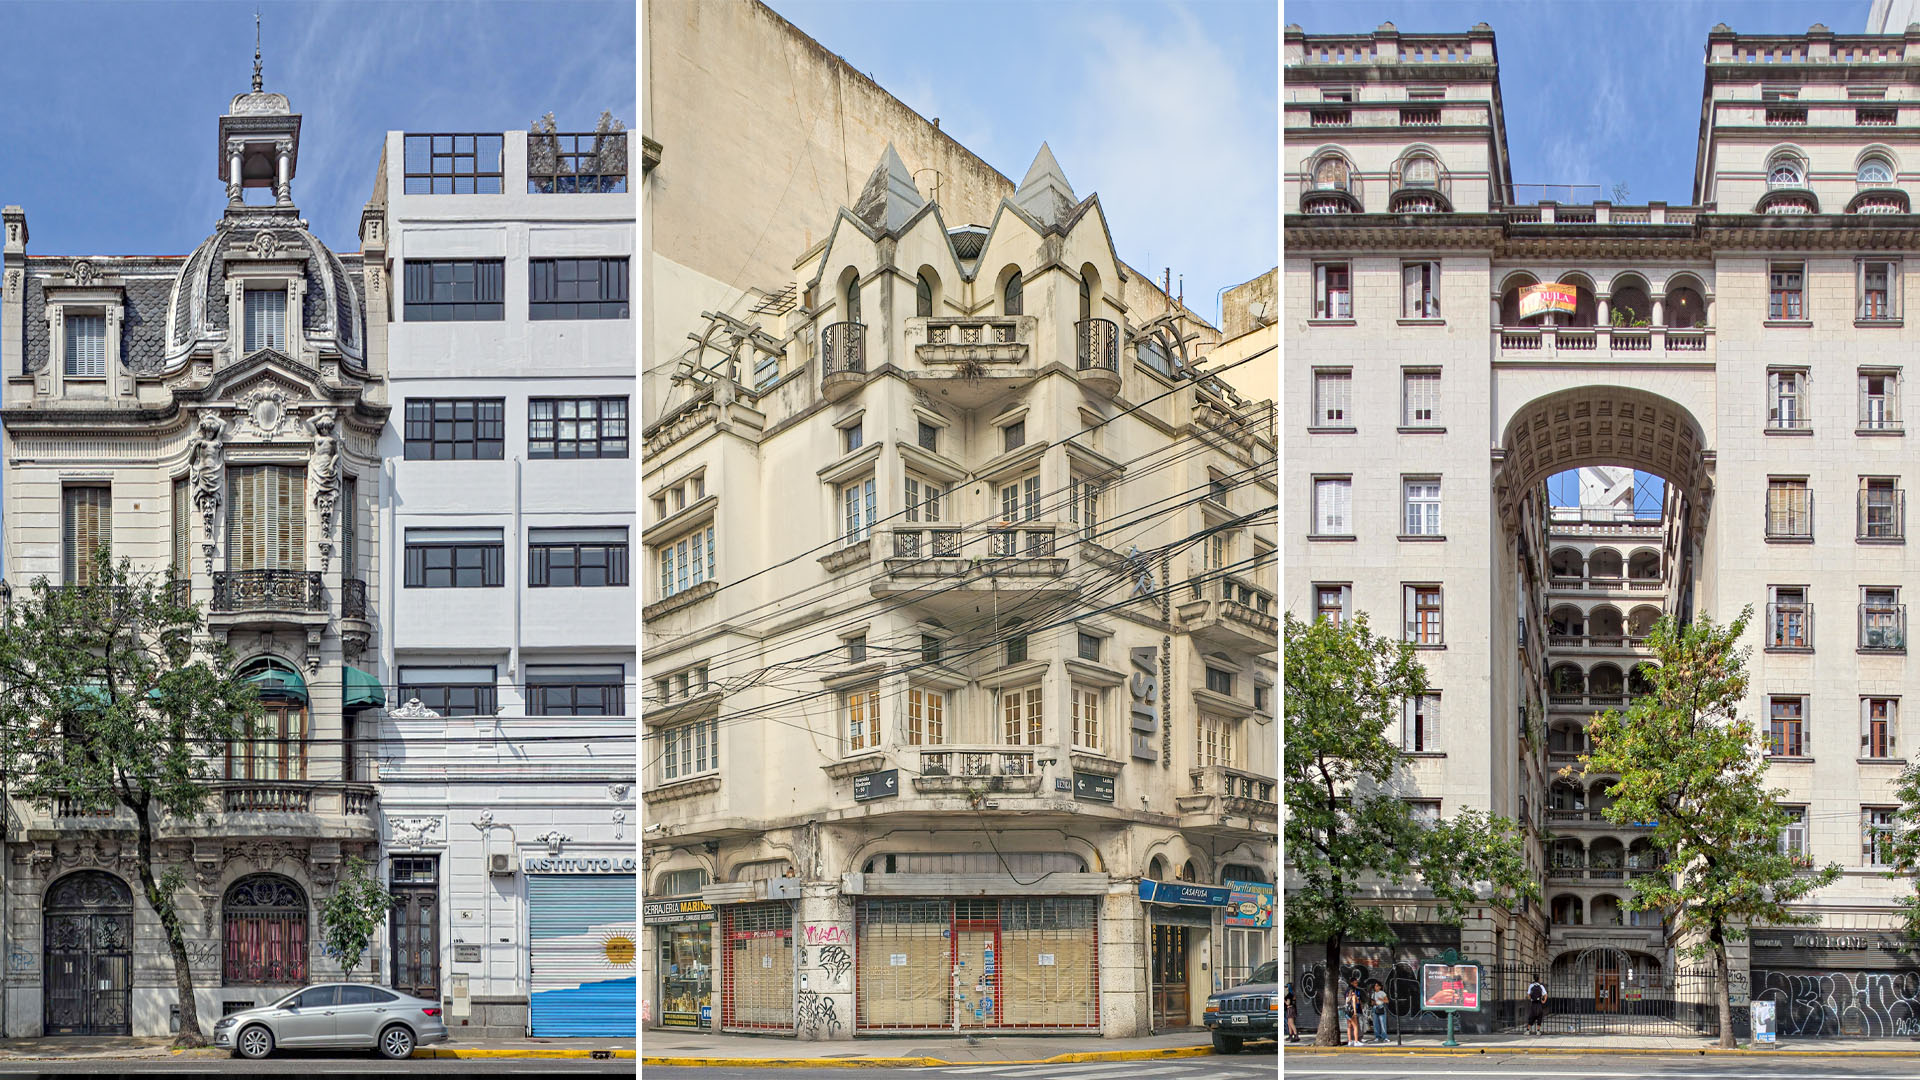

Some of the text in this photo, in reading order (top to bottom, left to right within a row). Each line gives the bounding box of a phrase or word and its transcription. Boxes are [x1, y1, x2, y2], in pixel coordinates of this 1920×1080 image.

[1131, 646, 1158, 762] FUSA
[525, 858, 612, 872] INSTITUTO
[645, 901, 712, 915] CERRAJERIA MARINA
[1793, 934, 1868, 949] MORRONE
